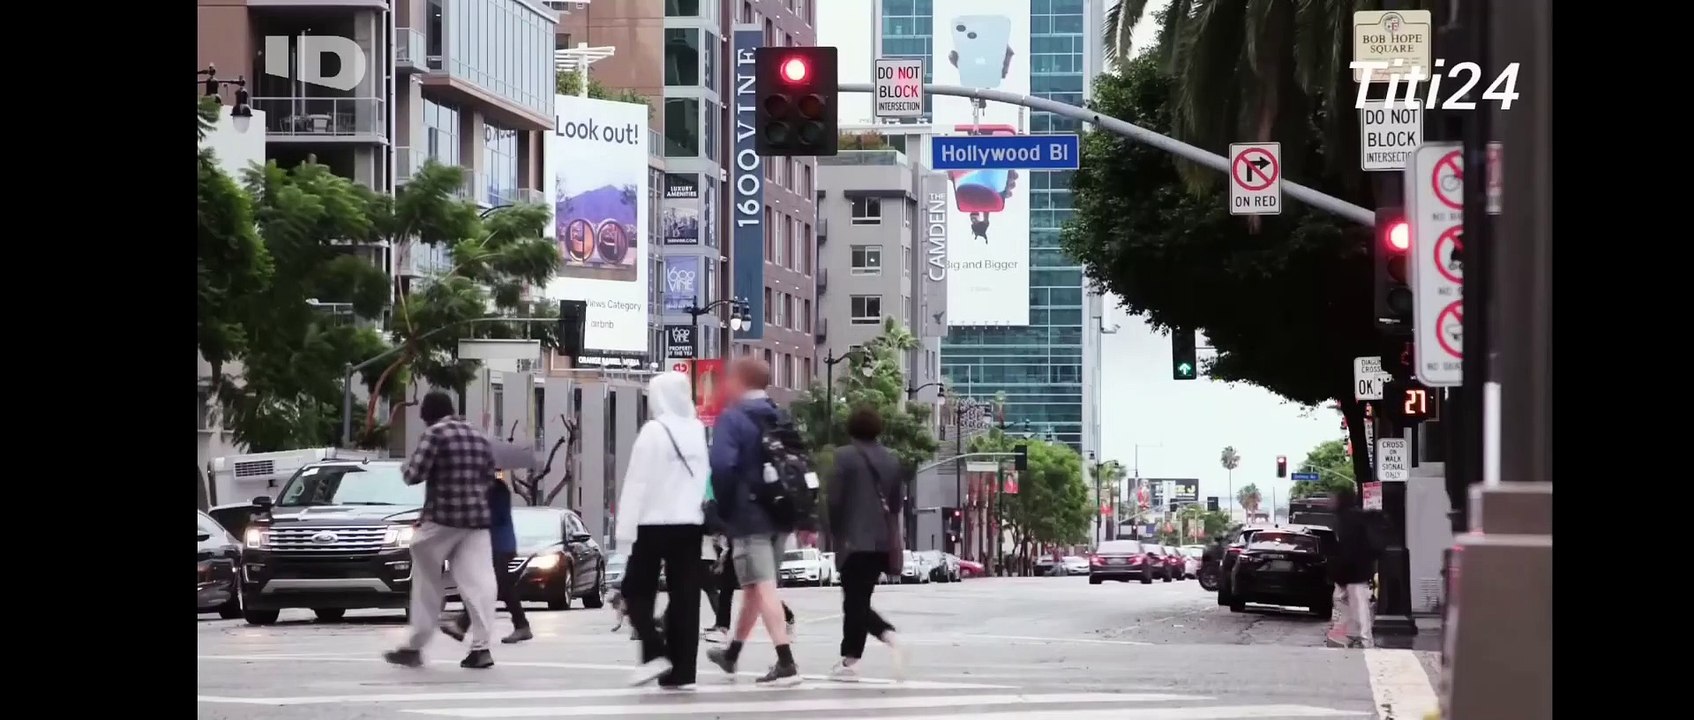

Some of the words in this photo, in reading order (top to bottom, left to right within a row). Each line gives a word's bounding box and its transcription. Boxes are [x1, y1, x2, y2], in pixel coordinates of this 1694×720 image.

[1363, 35, 1386, 44] BOB
[1391, 34, 1423, 44] HOPE
[1370, 45, 1415, 55] SQUARE
[878, 66, 894, 80] DO
[898, 66, 920, 80] NOT
[737, 46, 756, 142] VINE
[880, 85, 919, 98] BLOCK
[878, 101, 920, 111] INTERSECTION
[1366, 109, 1385, 125] DO
[1391, 109, 1418, 125] NOT
[556, 115, 599, 141] Look
[603, 123, 638, 145] out!
[1368, 131, 1416, 147] BLOCK
[942, 144, 1041, 166] Hollywood
[1050, 143, 1068, 161] Bl
[1367, 151, 1413, 163] INTERSECTI
[737, 149, 760, 227] 1600
[1235, 196, 1250, 208] ON
[1254, 195, 1276, 207] RED
[929, 200, 946, 281] CAMDEN
[962, 260, 982, 269] and
[984, 260, 1018, 272] Bigger
[668, 280, 694, 292] VINE
[607, 300, 641, 312] Category
[591, 320, 614, 329] airbnb
[1359, 379, 1374, 395] OK
[1404, 390, 1427, 415] 27
[1385, 471, 1402, 479] ONLY
